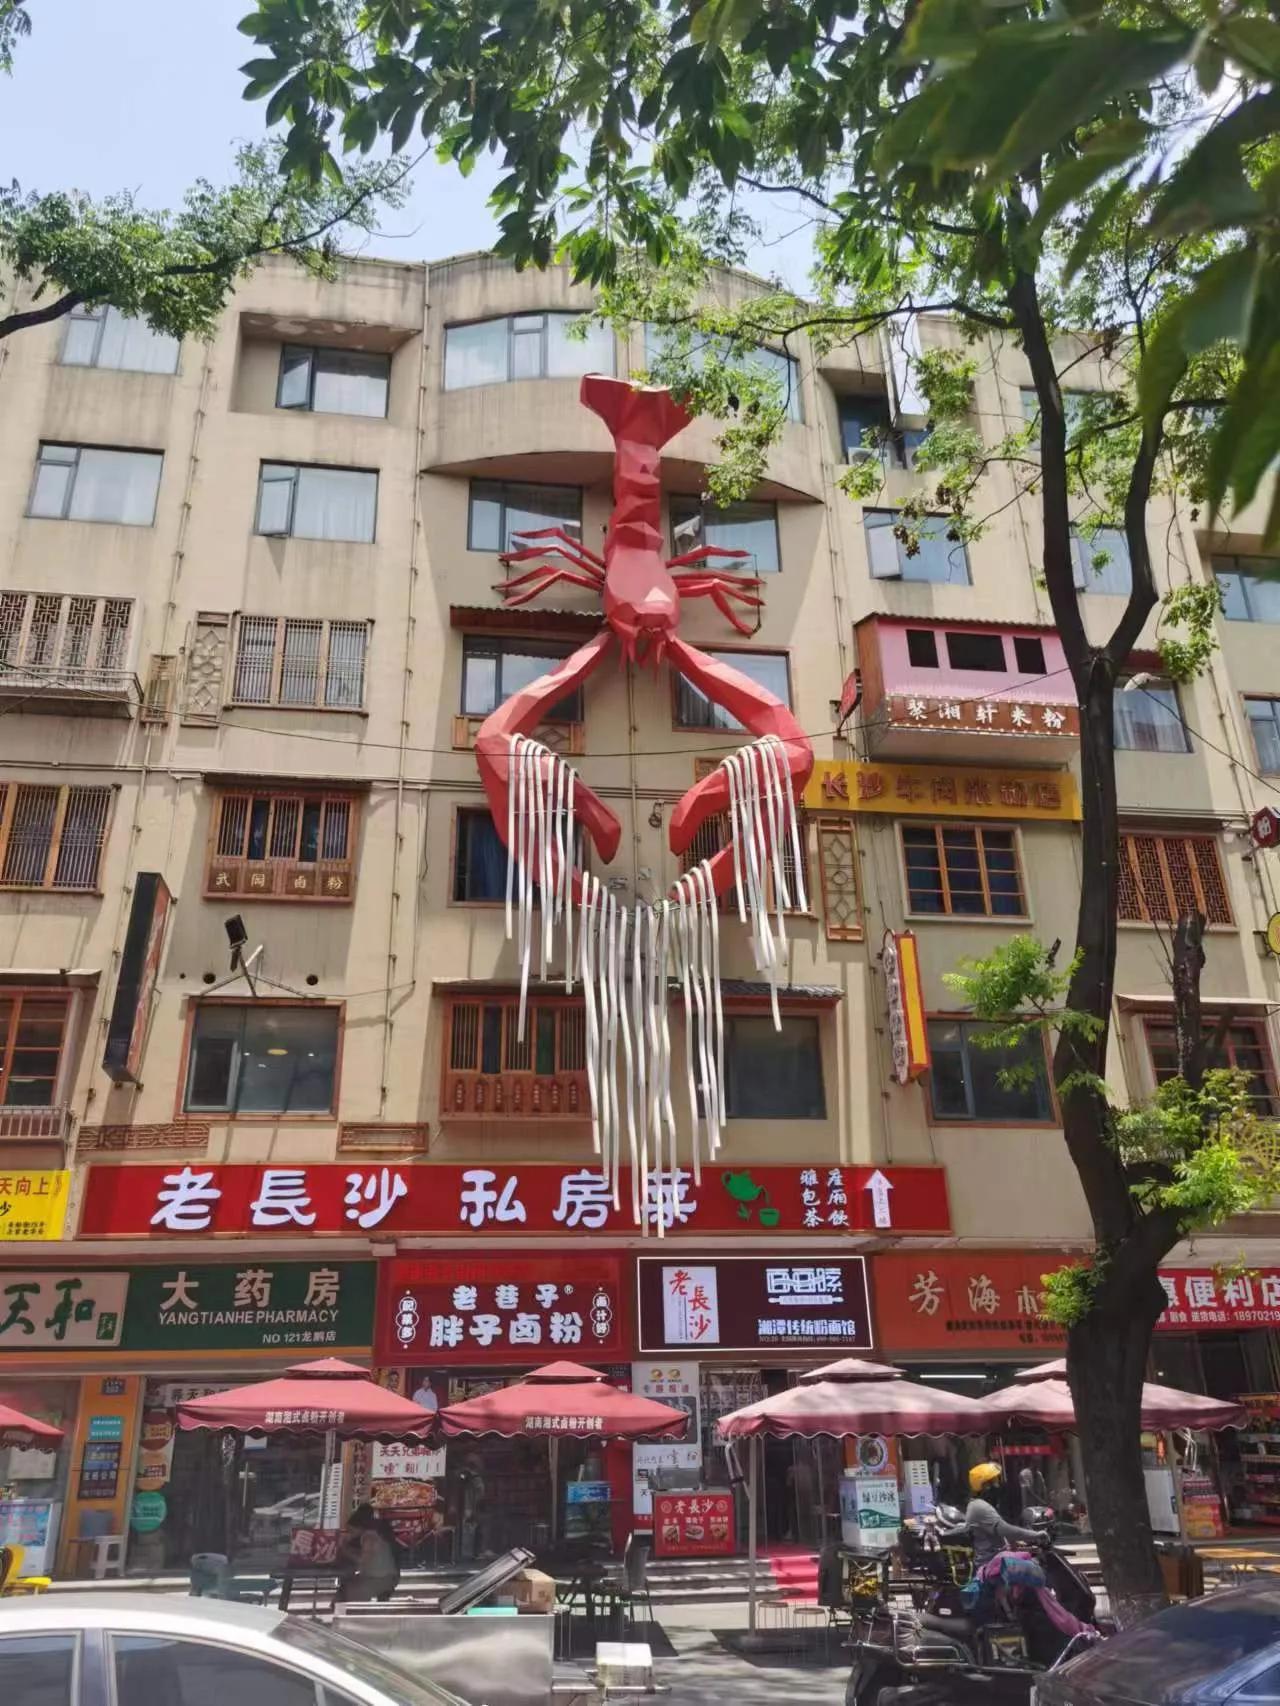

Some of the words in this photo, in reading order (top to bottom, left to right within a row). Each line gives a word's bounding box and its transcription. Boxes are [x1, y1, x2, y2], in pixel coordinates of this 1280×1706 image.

[159, 1268, 340, 1309] 大药房
[453, 1284, 559, 1310] 老巷子
[159, 1311, 252, 1325] YANGTIANHE
[256, 1310, 339, 1323] PHARMACY
[429, 1312, 583, 1347] 胖子卤粉
